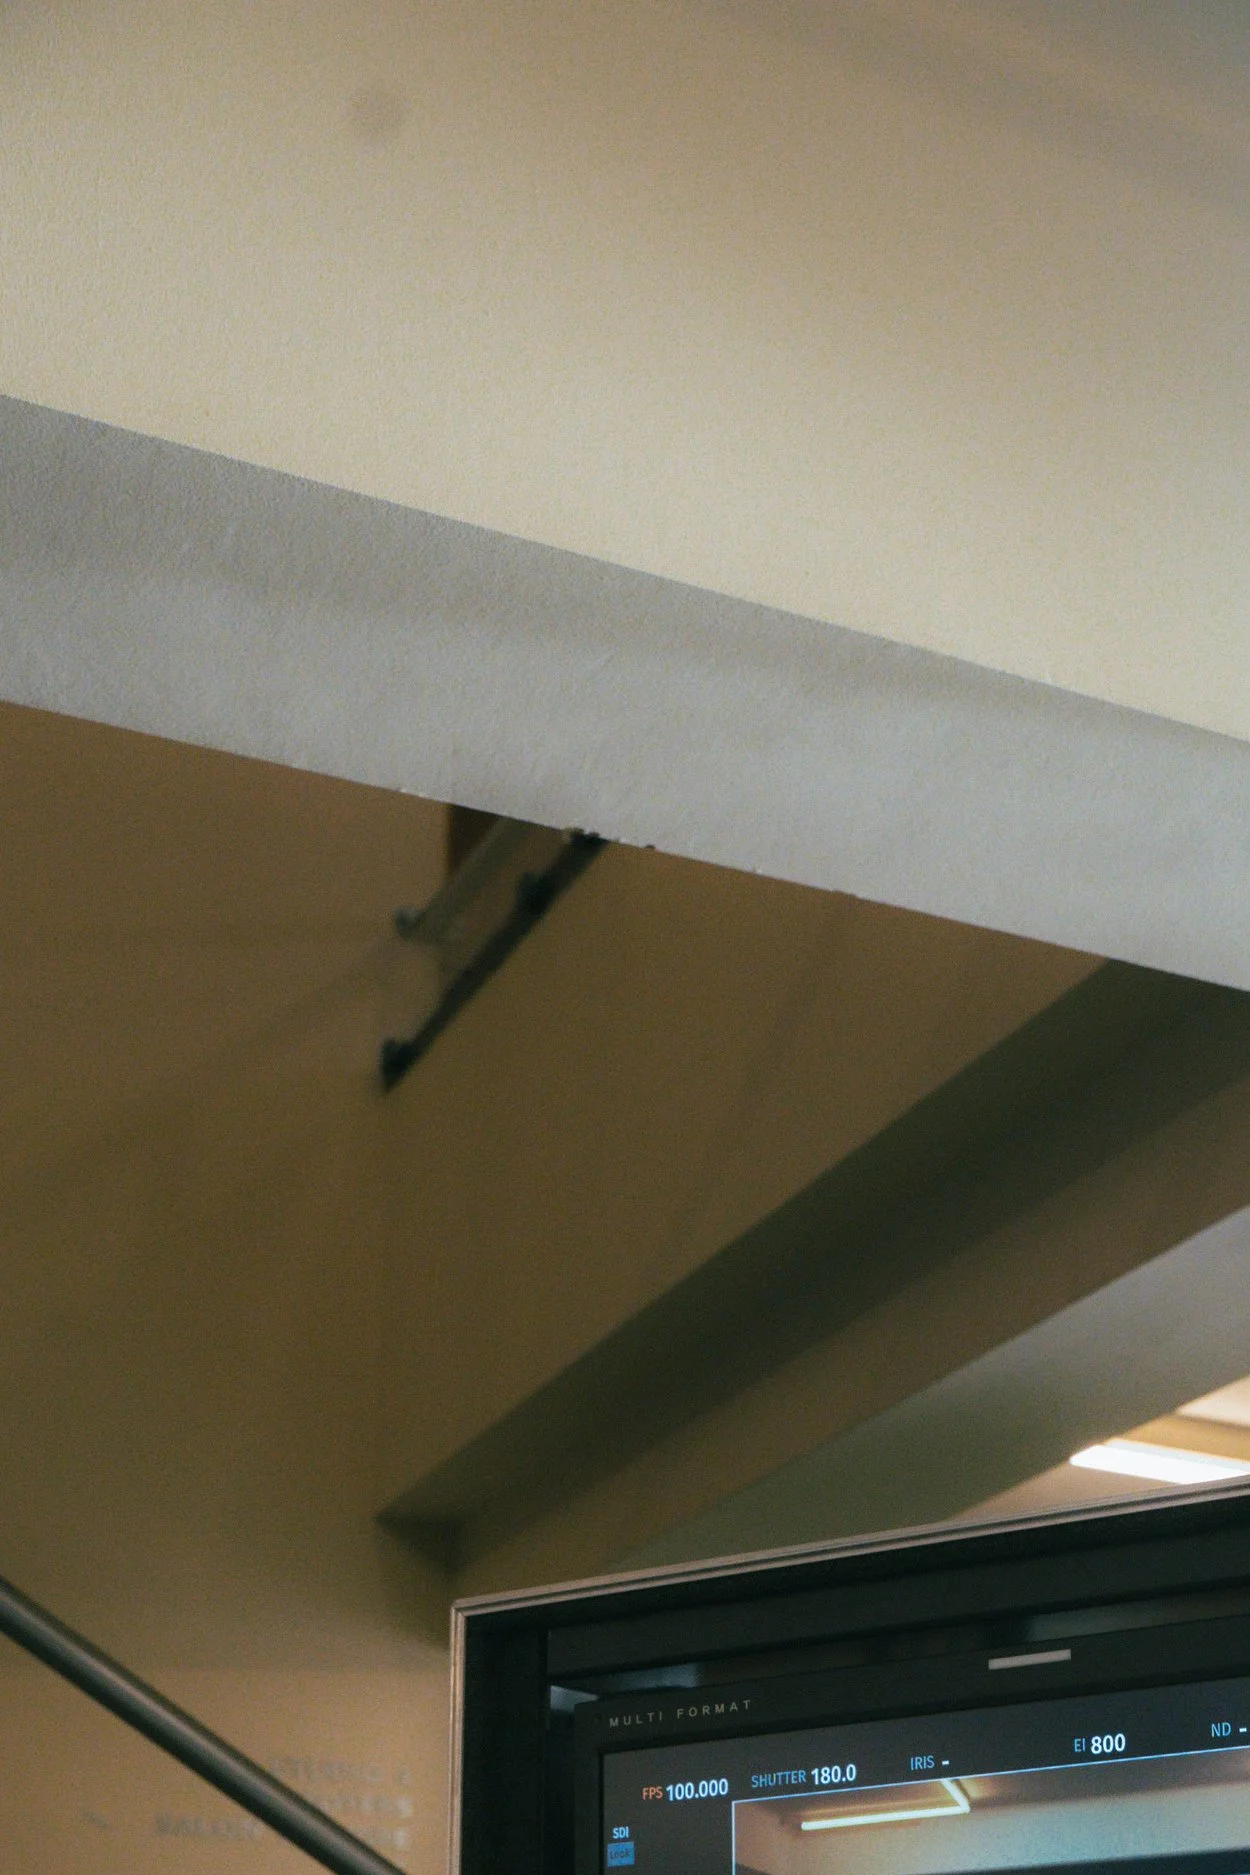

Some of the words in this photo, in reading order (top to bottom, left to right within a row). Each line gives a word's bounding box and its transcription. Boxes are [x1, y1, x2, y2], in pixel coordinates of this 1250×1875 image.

[609, 1711, 663, 1728] MULTI
[676, 1699, 752, 1719] FORMAT
[1211, 1720, 1232, 1738] ND
[1073, 1736, 1086, 1752] EI
[1090, 1733, 1127, 1755] 800
[910, 1753, 936, 1771] IRIS
[751, 1768, 807, 1789] SHUTTER
[811, 1763, 857, 1786] 180.0
[642, 1785, 664, 1801] FPS
[666, 1777, 729, 1802] 100.000
[612, 1825, 630, 1840] SDI
